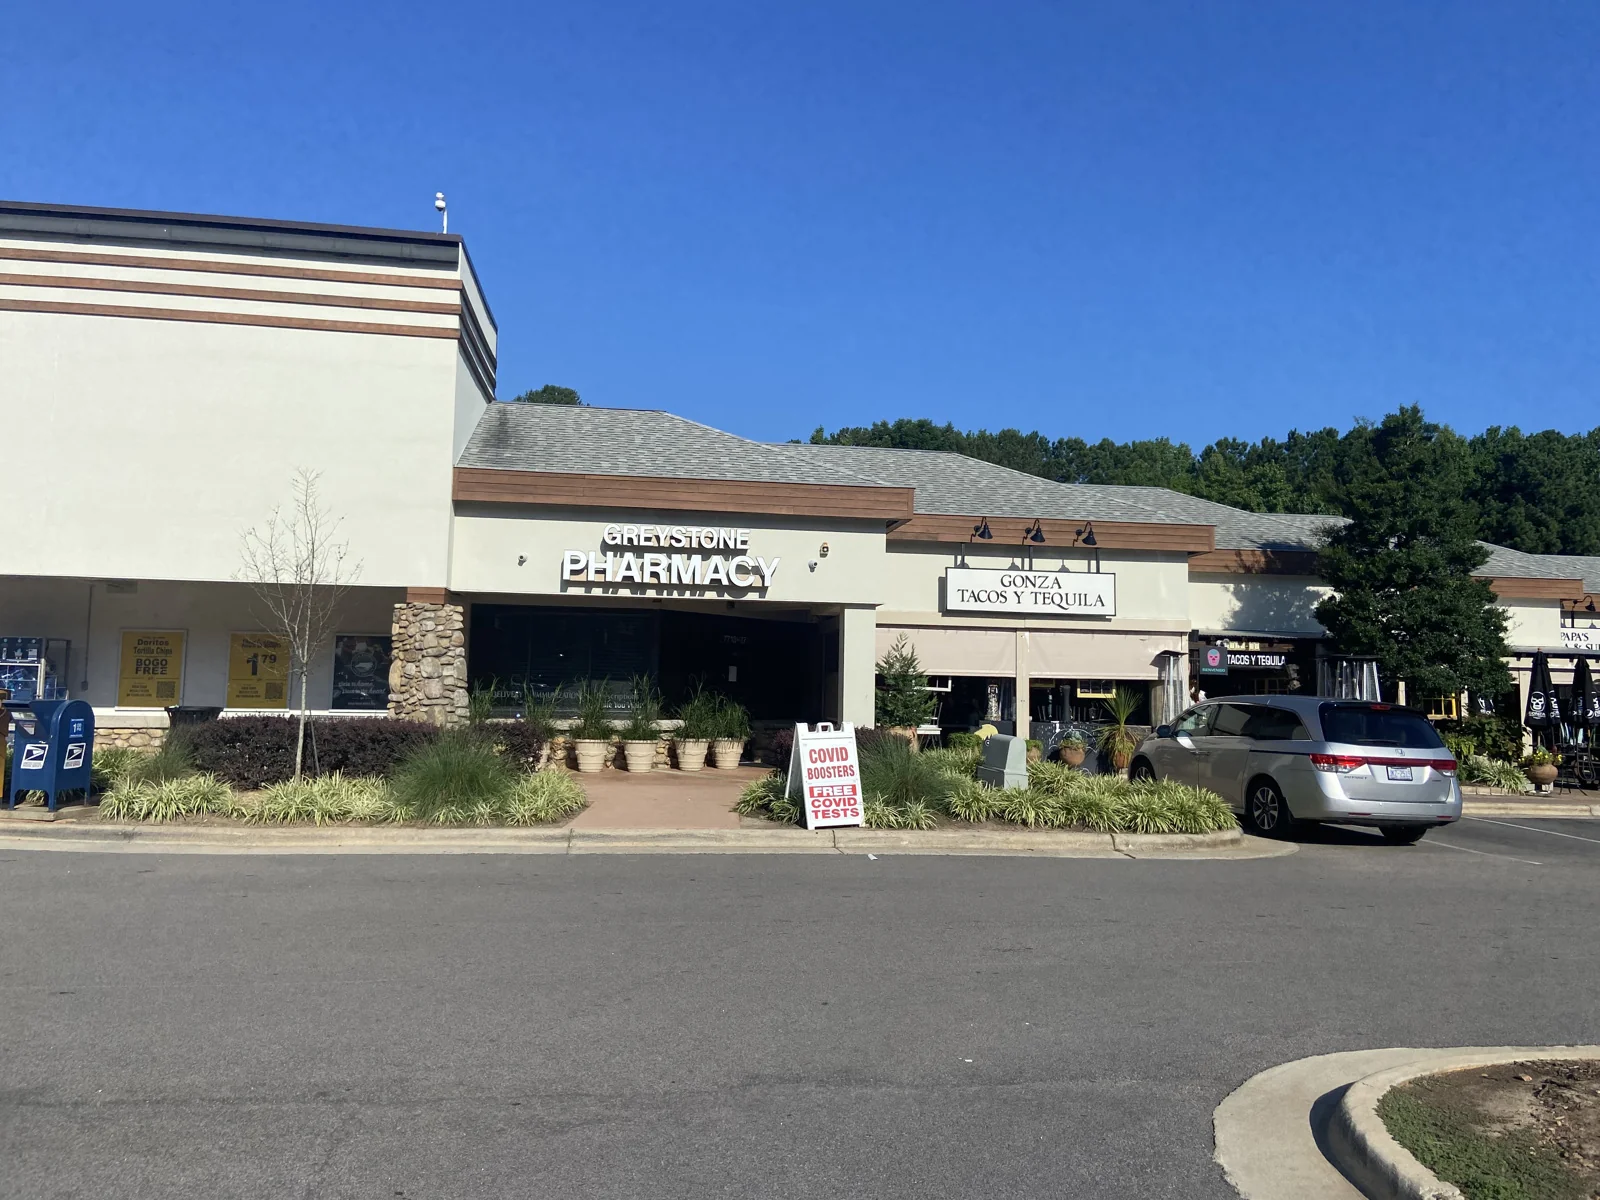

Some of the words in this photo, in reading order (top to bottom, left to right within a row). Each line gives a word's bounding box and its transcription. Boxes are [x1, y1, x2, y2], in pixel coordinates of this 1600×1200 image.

[603, 524, 750, 549] GREYSTONE
[562, 550, 780, 587] PHARMACY
[1000, 574, 1062, 589] GONZA
[957, 589, 1007, 604] TACOS
[1013, 591, 1024, 604] Y
[1030, 591, 1105, 610] TEQUILA
[136, 658, 168, 667] BOGO
[1227, 654, 1249, 665] TACOS
[1250, 655, 1256, 665] Y
[1257, 655, 1285, 666] TEQUILA
[135, 667, 168, 675] FREE
[809, 747, 848, 764] COVID
[807, 765, 855, 780] BOOSTERS
[813, 785, 853, 797] FREE
[811, 797, 857, 808] COVID
[811, 808, 859, 819] TESTS
